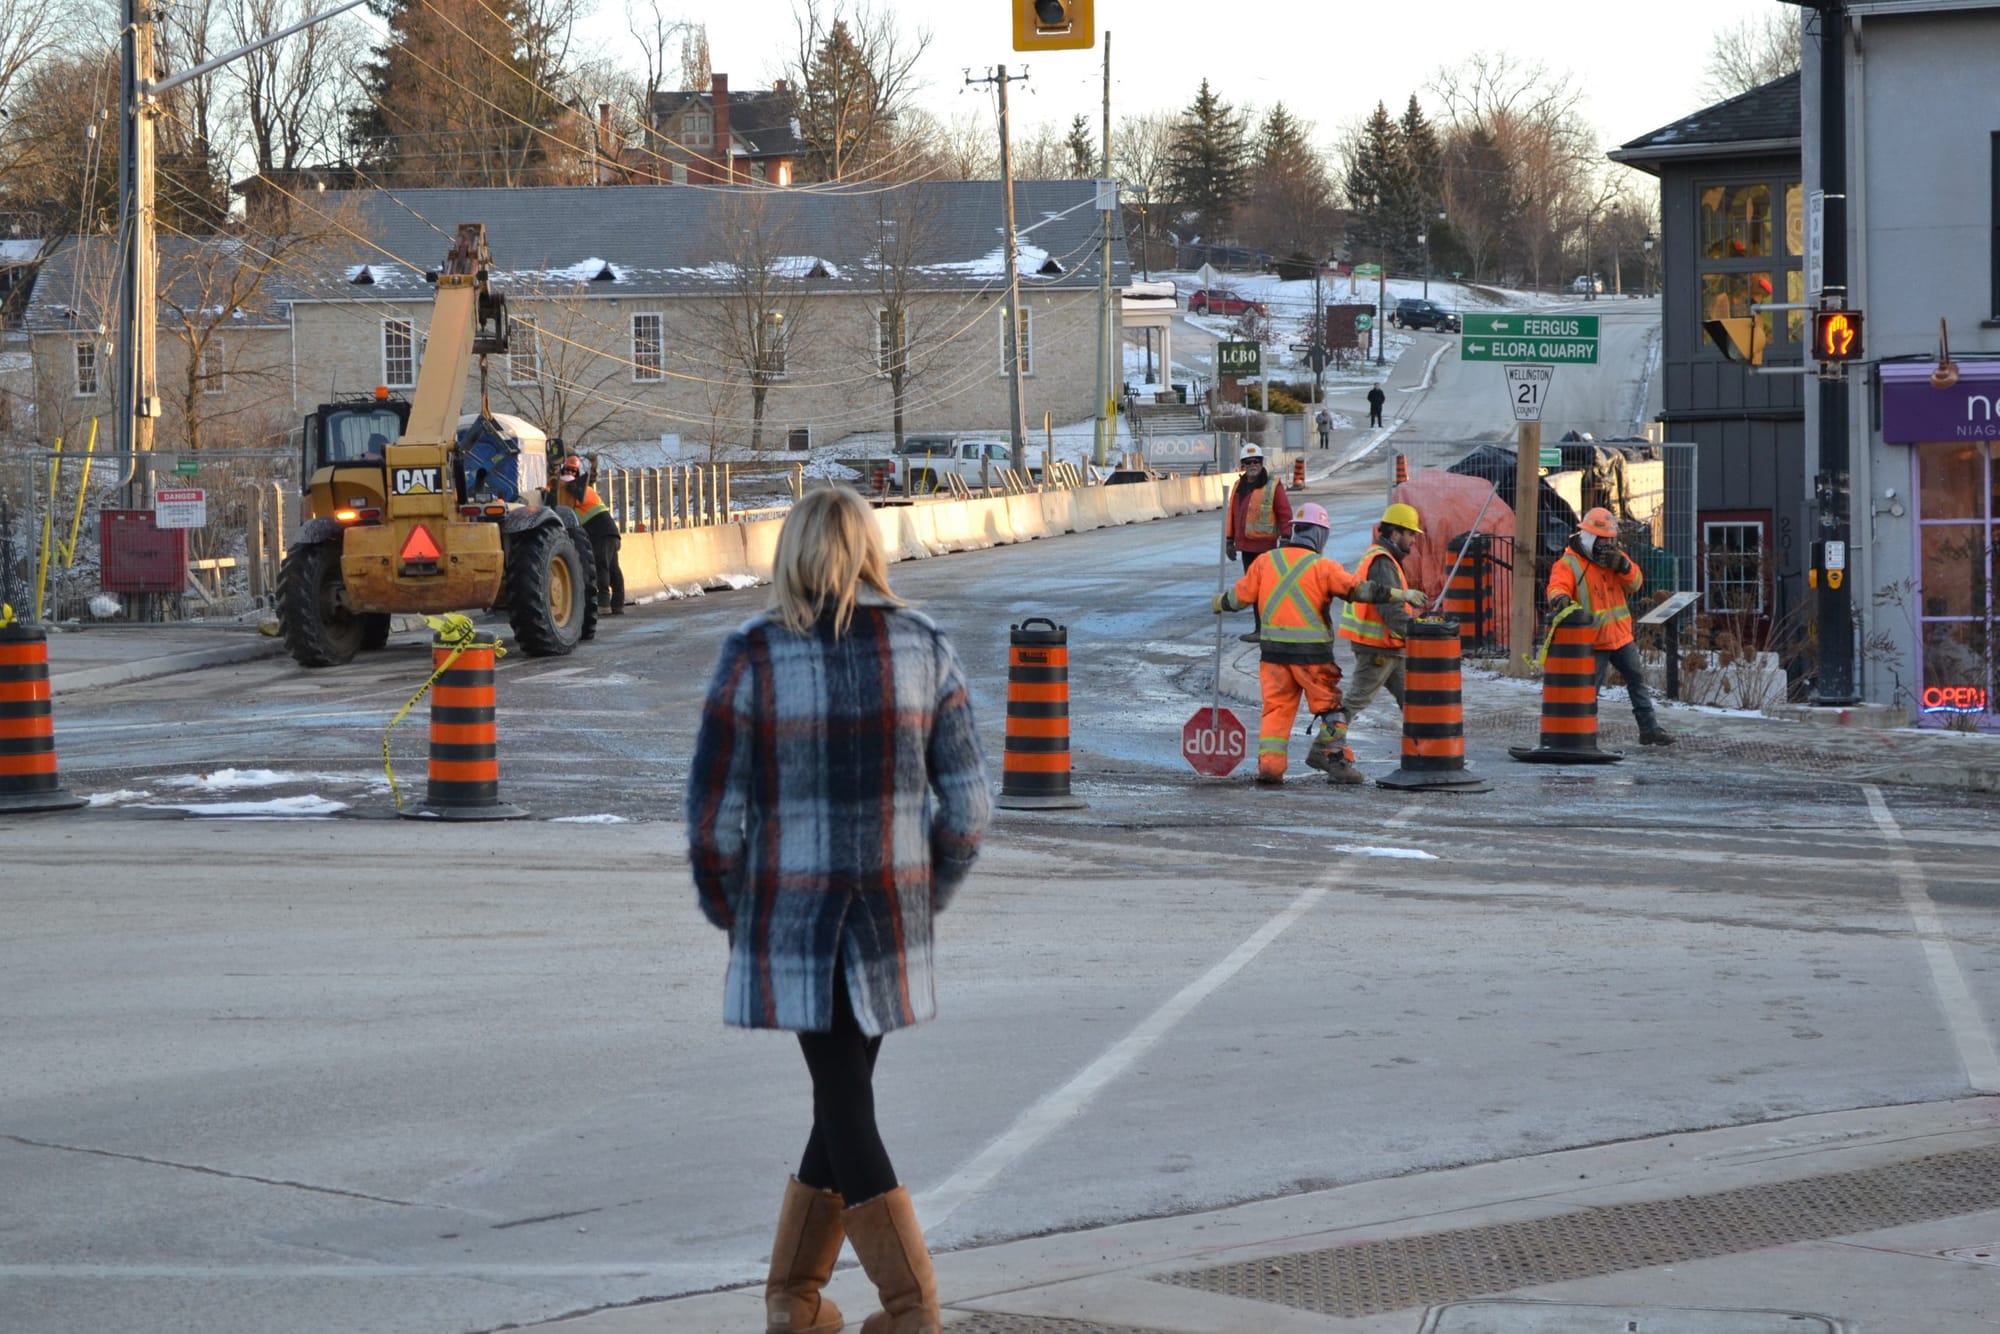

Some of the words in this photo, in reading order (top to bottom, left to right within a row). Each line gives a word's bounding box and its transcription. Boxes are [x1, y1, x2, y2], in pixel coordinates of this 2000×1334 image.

[1523, 319, 1579, 336] FERGUS
[1222, 349, 1257, 364] LCBO
[1491, 341, 1537, 357] ELORA
[1539, 343, 1594, 359] QUARRY
[1508, 367, 1550, 381] WELLINGTON
[1517, 383, 1537, 404] 21
[1516, 406, 1539, 415] COUNTY
[396, 468, 437, 495] CAT
[163, 493, 197, 501] DANGER
[1923, 686, 1985, 708] OPEN
[1185, 728, 1243, 757] STOP
